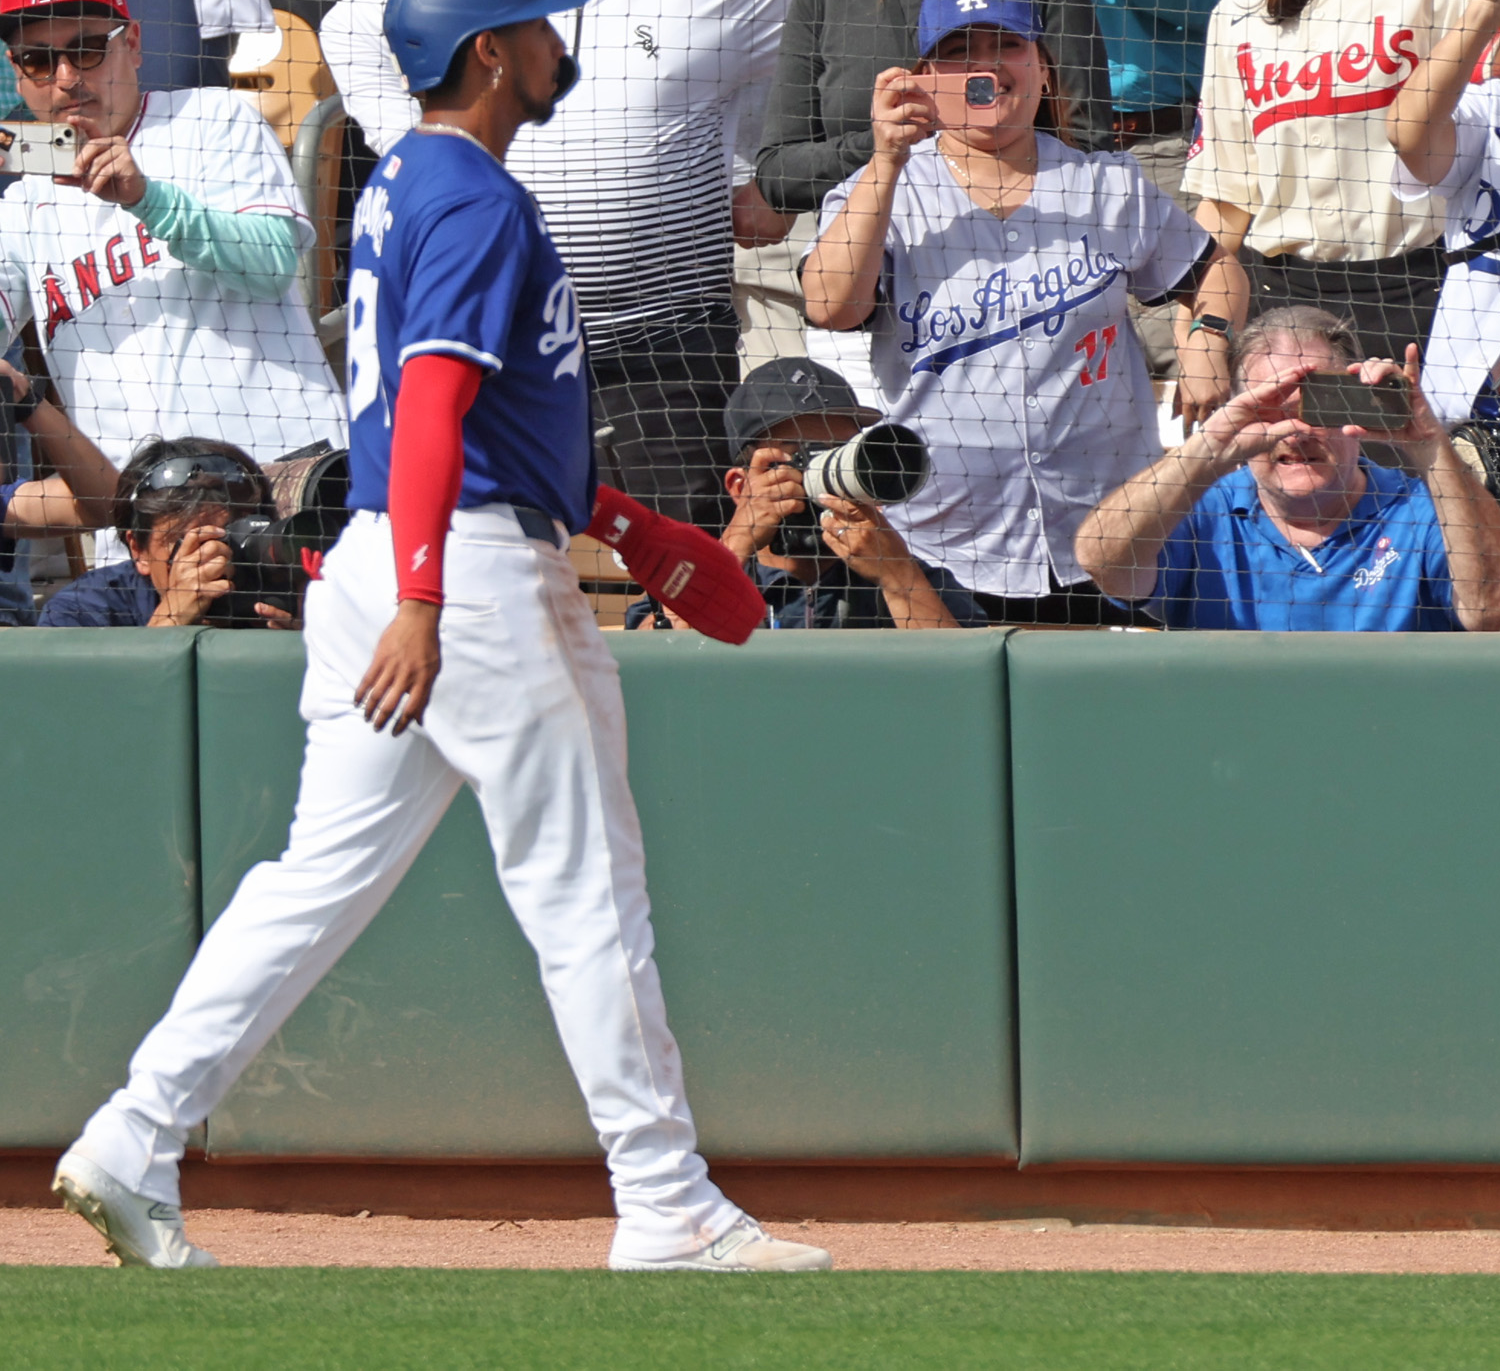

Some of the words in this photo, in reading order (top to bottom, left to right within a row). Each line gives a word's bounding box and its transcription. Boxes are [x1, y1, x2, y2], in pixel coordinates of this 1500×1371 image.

[634, 25, 659, 60] Sox
[1238, 15, 1419, 110] Angels
[899, 290, 964, 353] Los
[969, 235, 1124, 336] Angeles
[1352, 546, 1401, 590] Dodgers
